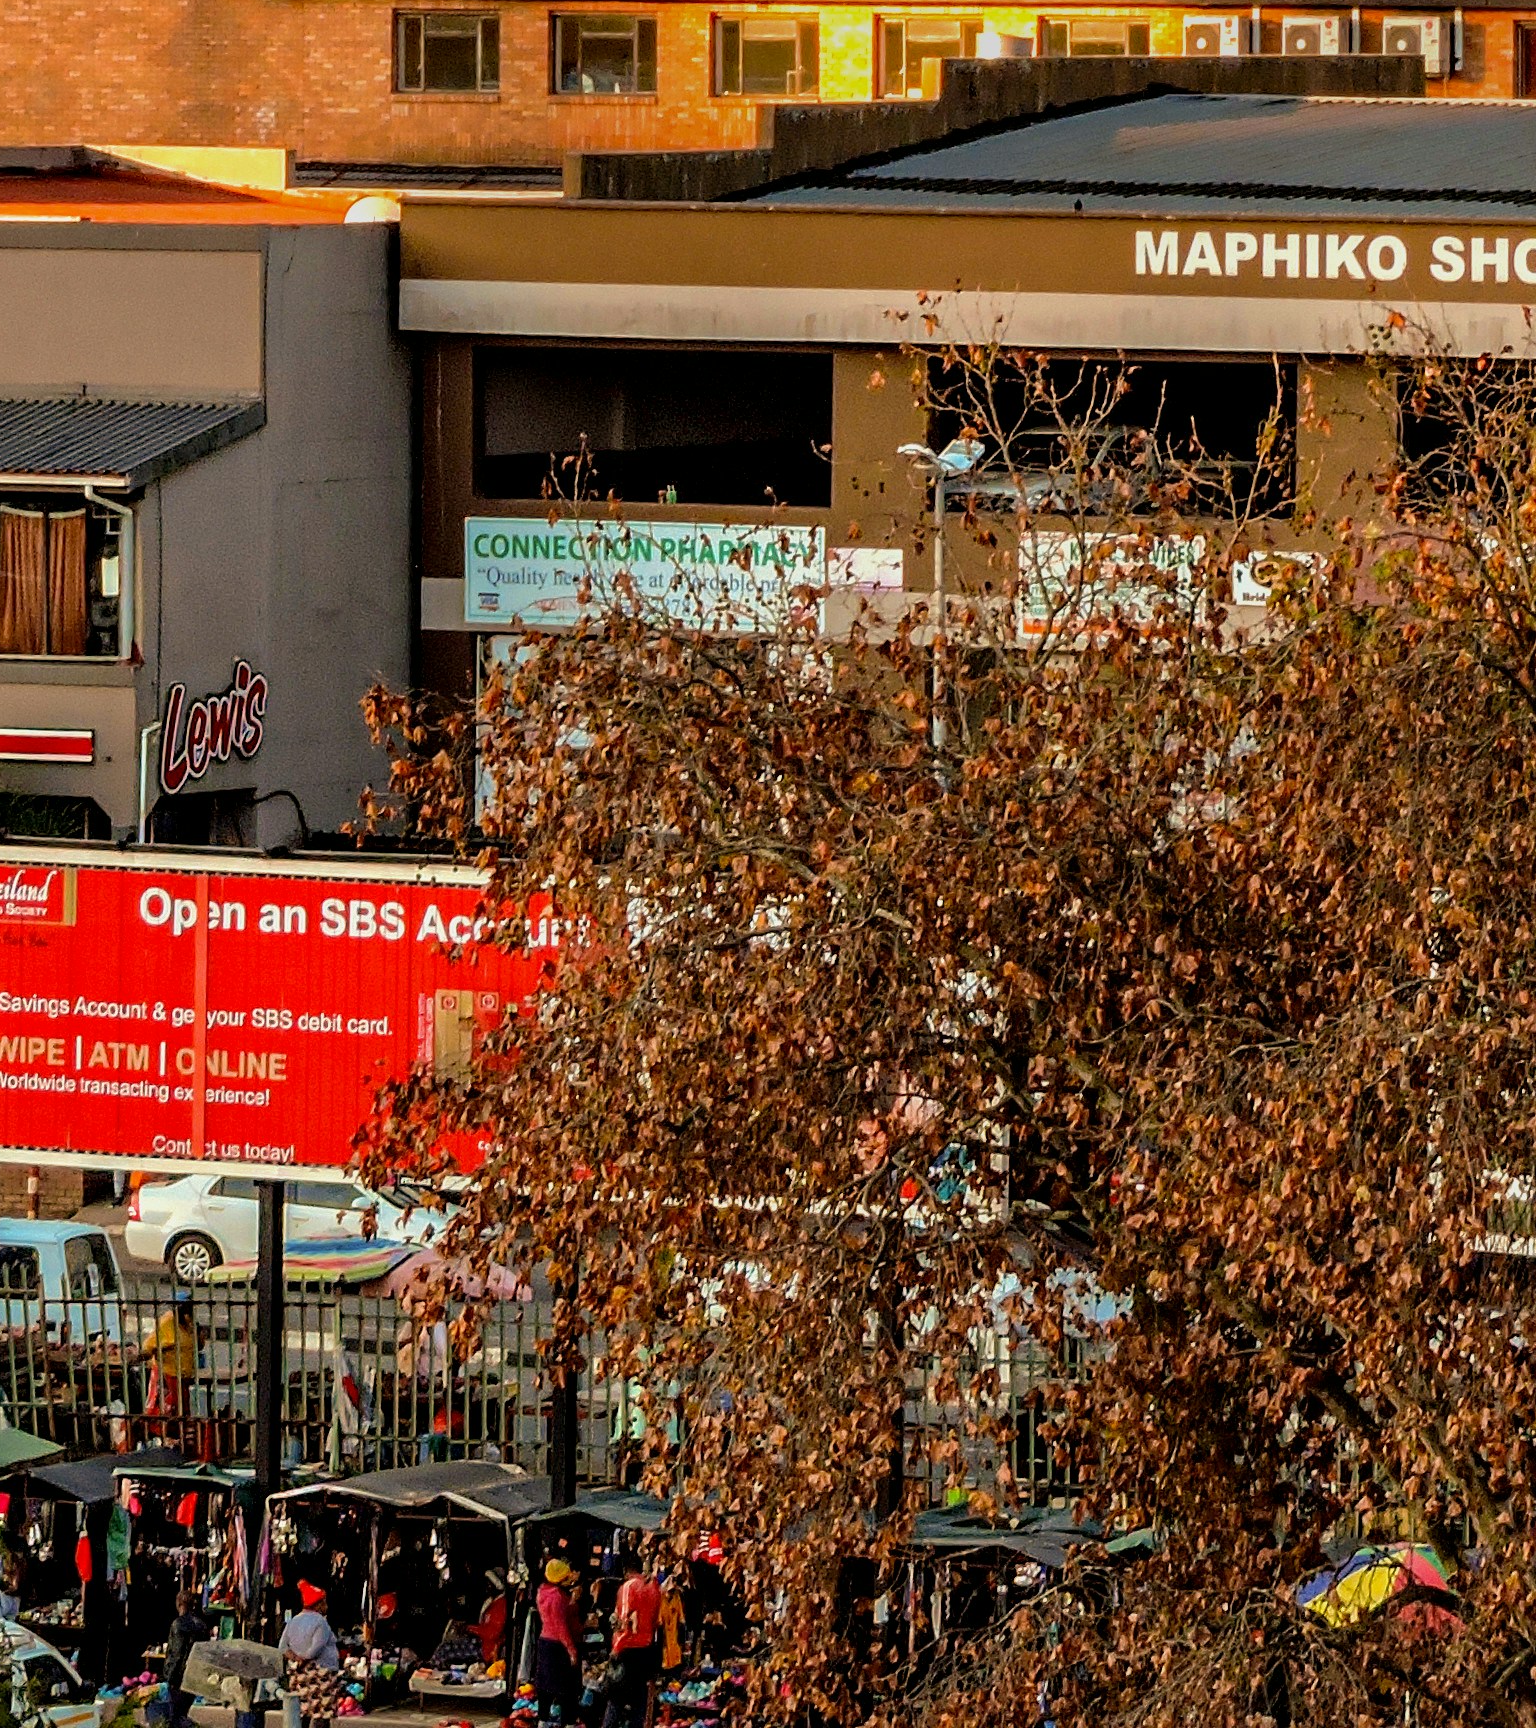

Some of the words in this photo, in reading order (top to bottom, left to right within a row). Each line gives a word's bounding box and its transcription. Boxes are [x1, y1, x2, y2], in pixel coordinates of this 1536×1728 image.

[1135, 230, 1408, 282] MAPHIKO
[474, 534, 652, 562] CONNECTION
[649, 573, 664, 588] at
[161, 661, 268, 794] Lewis
[139, 887, 246, 937] Open
[259, 904, 307, 934] an
[320, 897, 405, 940] SBS
[74, 996, 147, 1020] Account
[152, 1001, 167, 1021] &
[172, 1007, 200, 1028] ge
[207, 1010, 247, 1030] your
[252, 1008, 293, 1030] SBS
[298, 1013, 343, 1034] debit
[347, 1016, 393, 1036] card.
[88, 1041, 150, 1071] ATM
[80, 1078, 169, 1102] transacting
[174, 1087, 270, 1106] exerience!
[152, 1135, 217, 1156] Contct
[221, 1142, 241, 1158] us
[245, 1144, 295, 1163] today!
